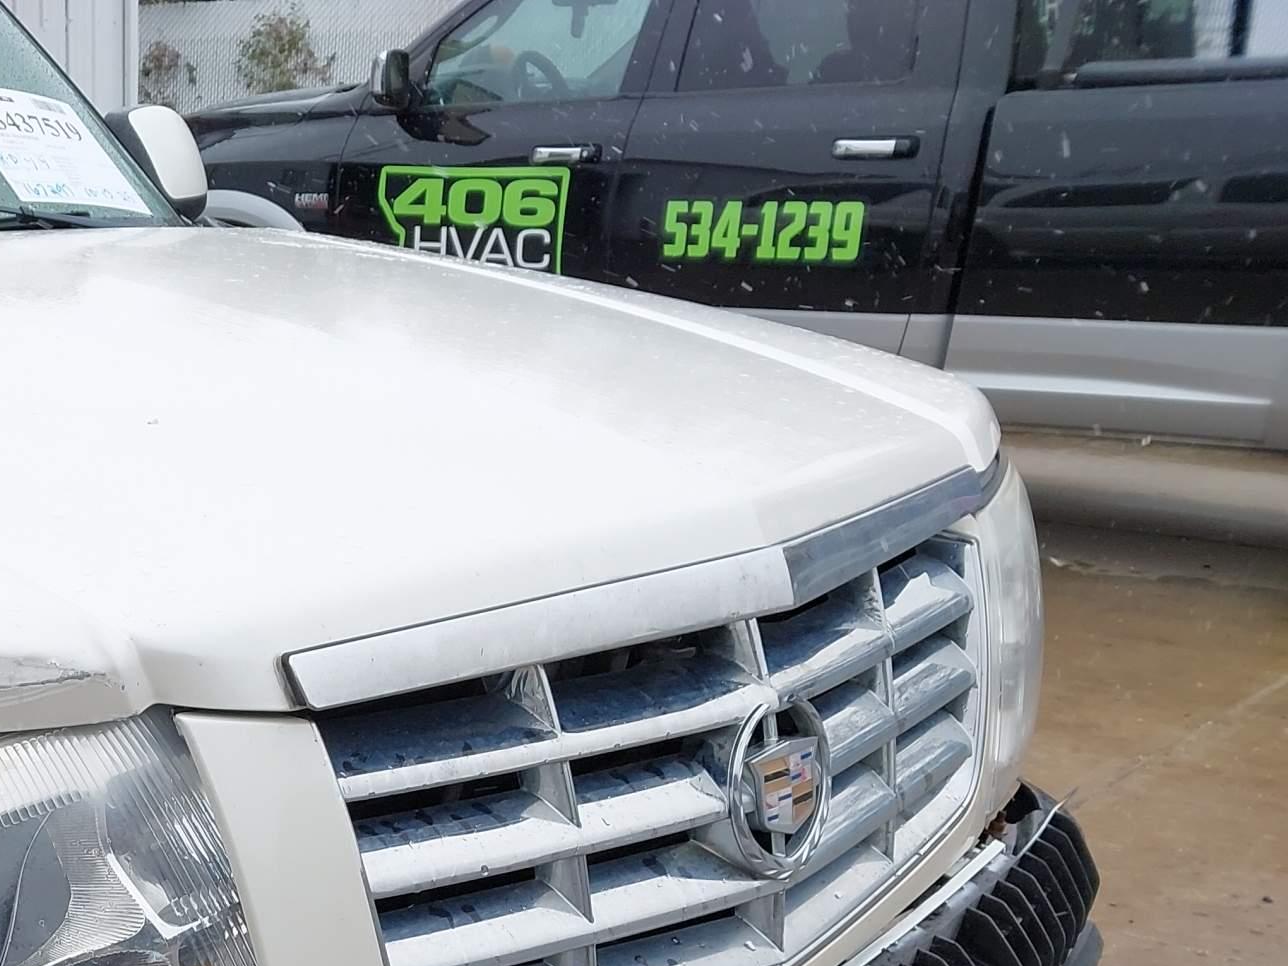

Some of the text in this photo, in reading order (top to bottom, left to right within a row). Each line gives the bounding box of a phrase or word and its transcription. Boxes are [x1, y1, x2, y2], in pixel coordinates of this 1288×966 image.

[393, 178, 559, 227] 406
[414, 225, 552, 269] HVAC
[662, 200, 865, 261] 534-1239
